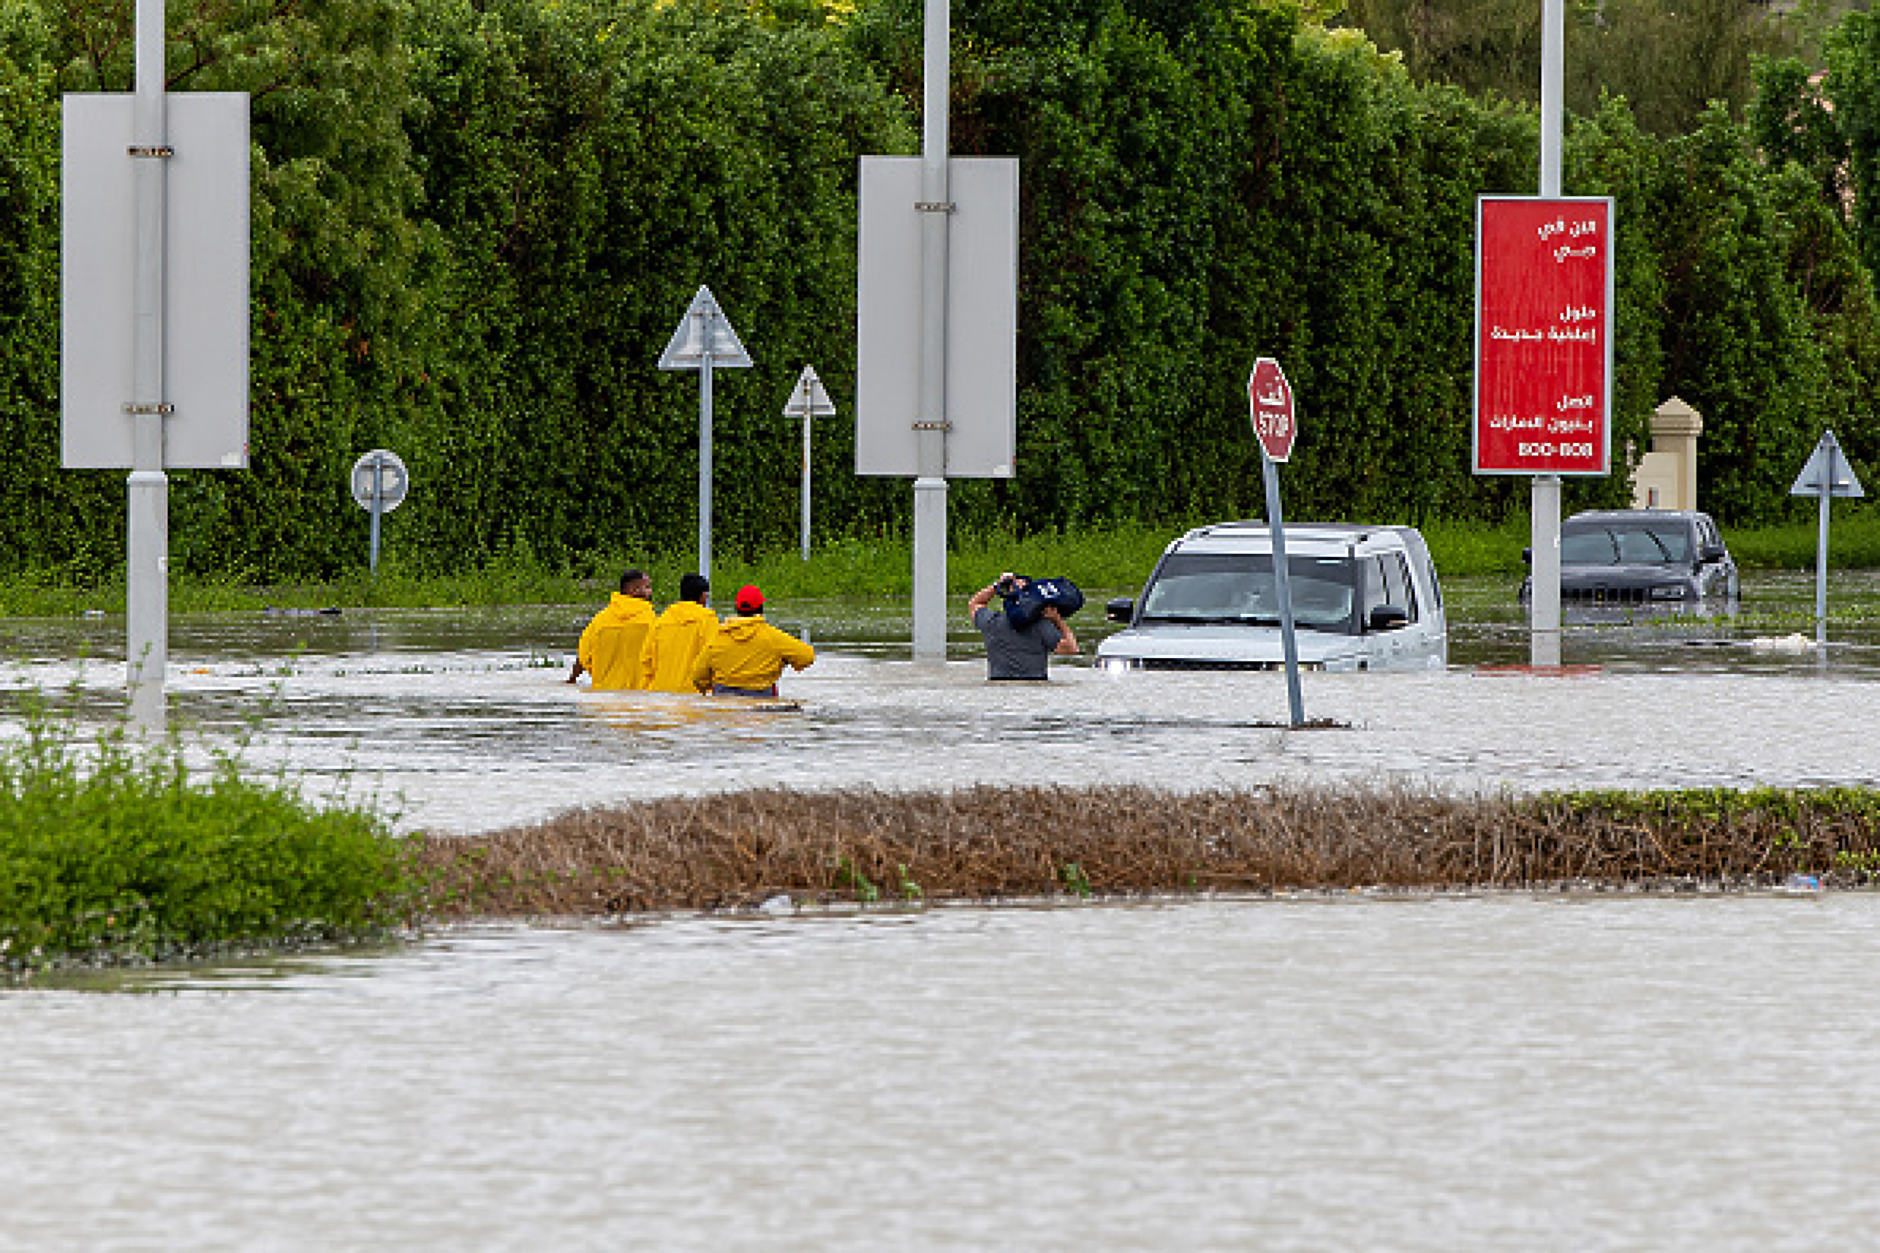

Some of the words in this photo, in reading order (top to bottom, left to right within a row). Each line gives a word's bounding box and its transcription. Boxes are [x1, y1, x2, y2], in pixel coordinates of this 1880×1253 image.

[1559, 303, 1596, 323] حلول
[1256, 376, 1286, 407] قف
[1258, 410, 1289, 438] STOP
